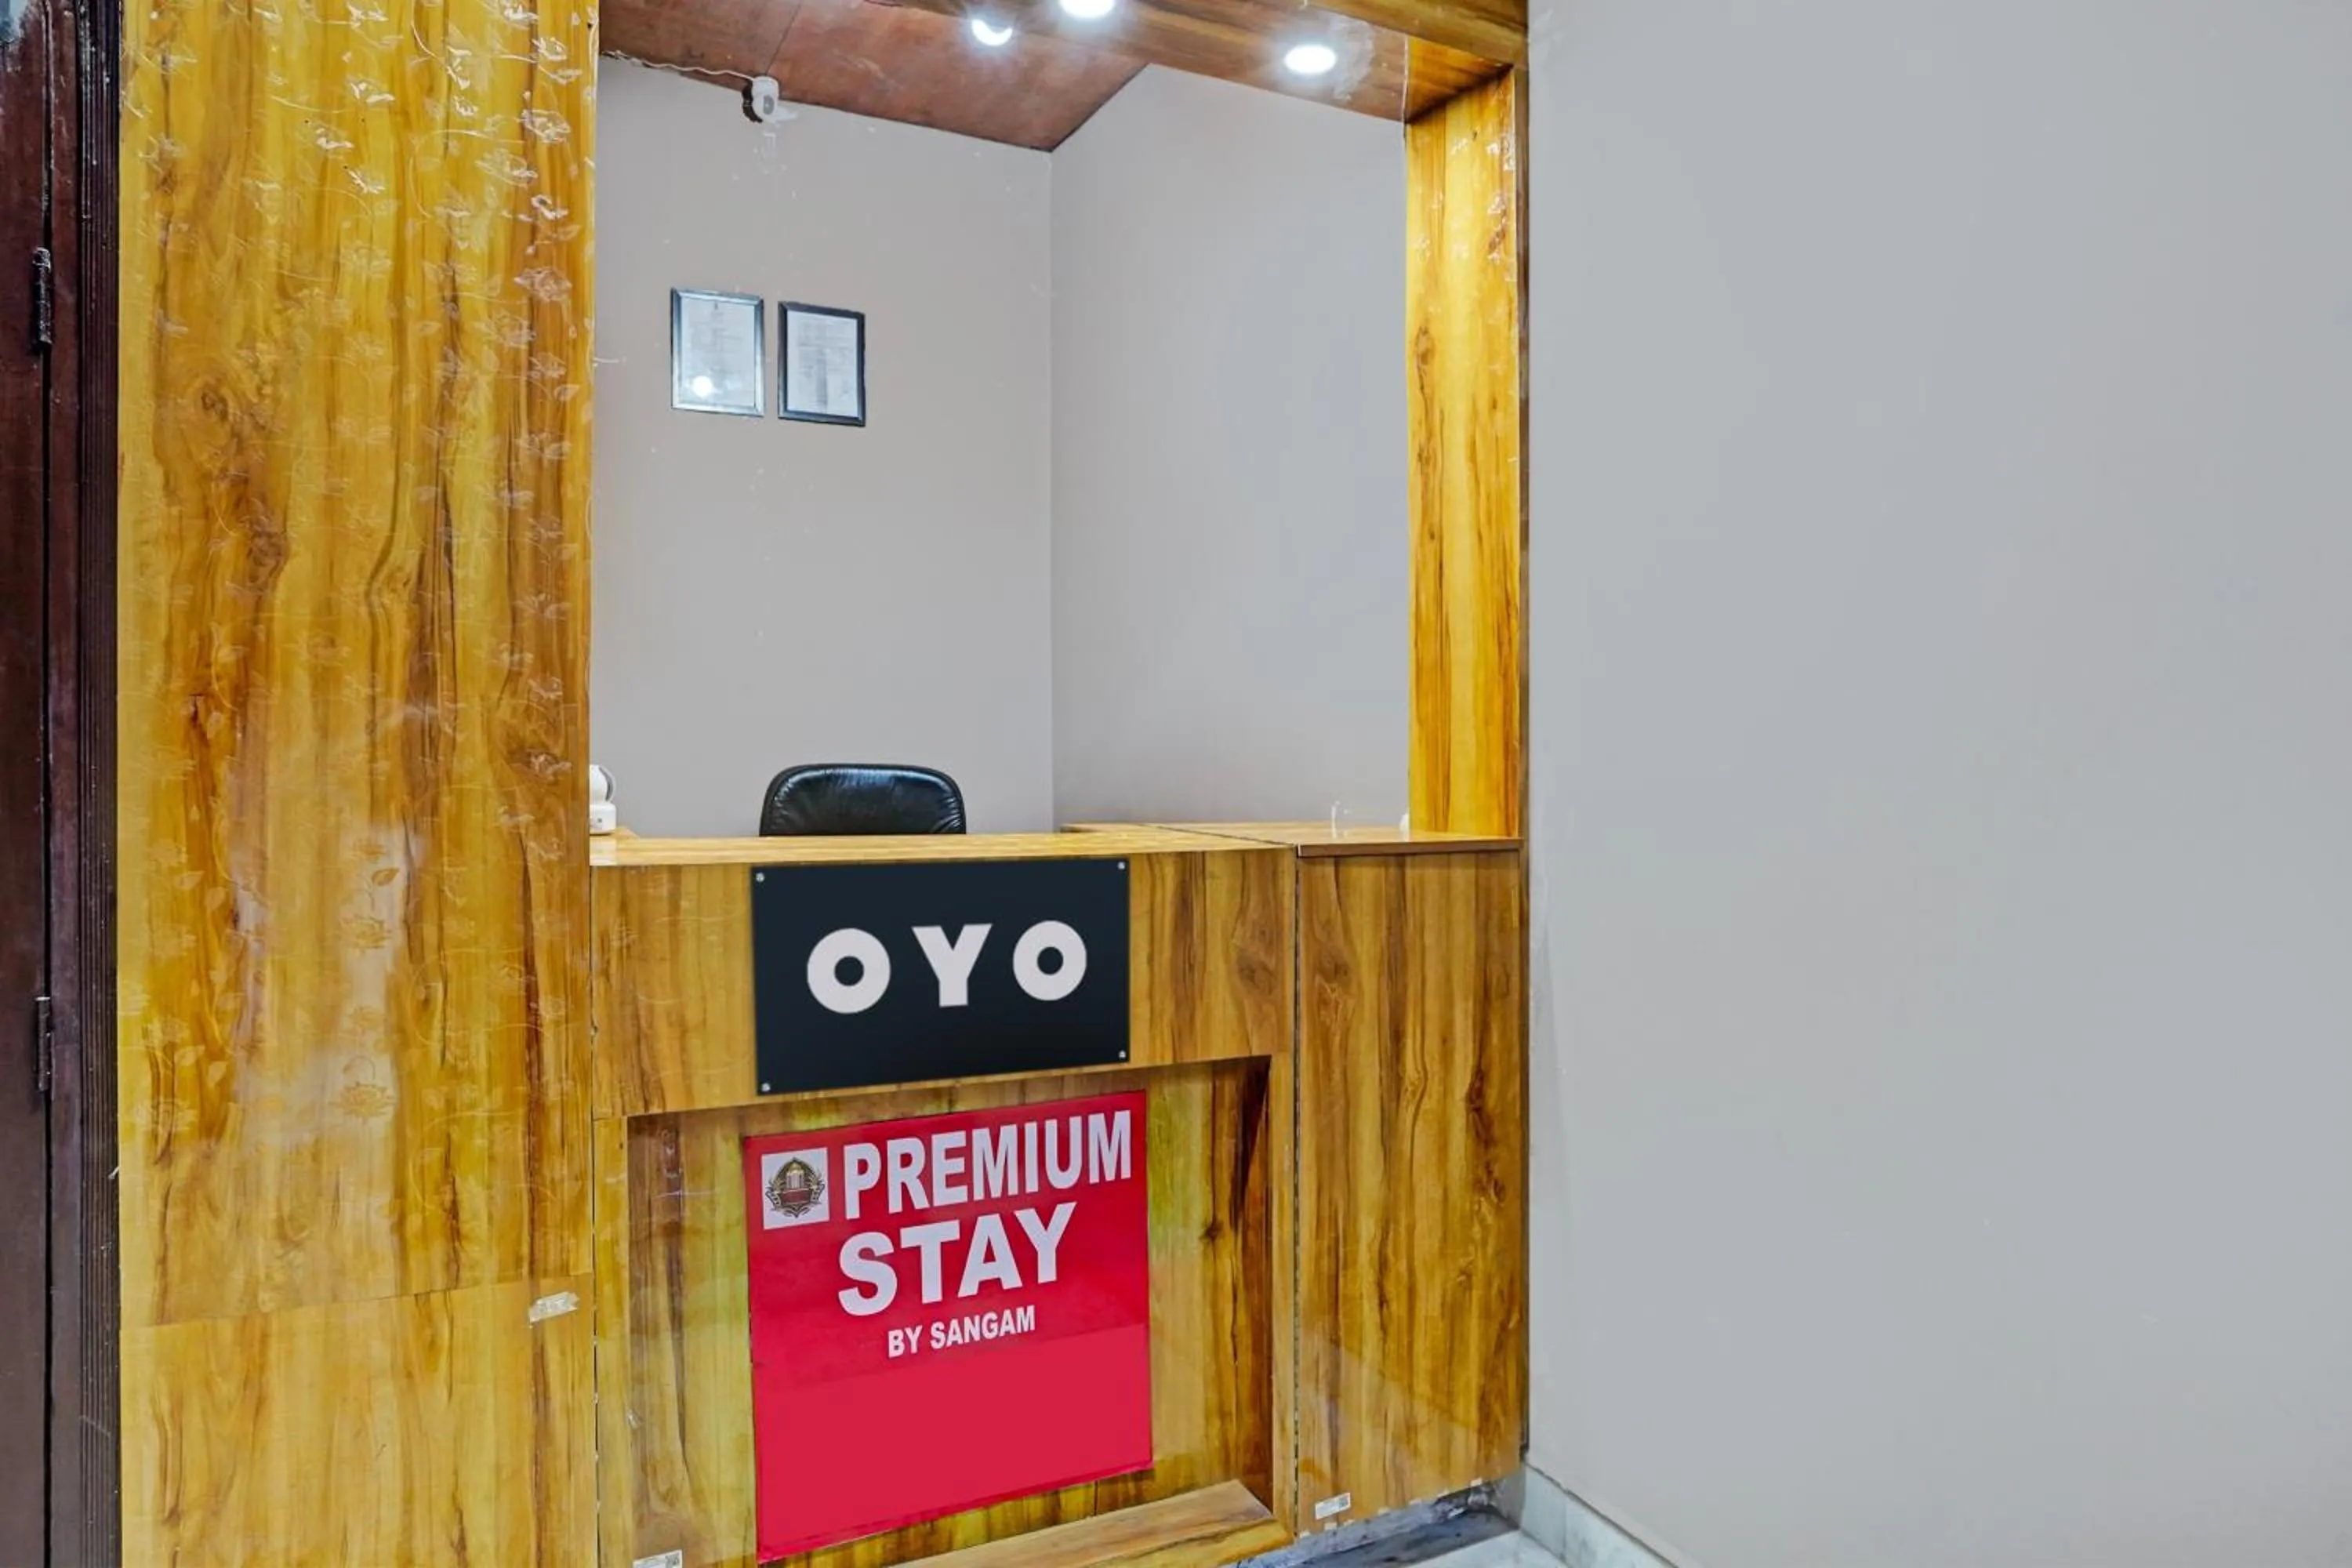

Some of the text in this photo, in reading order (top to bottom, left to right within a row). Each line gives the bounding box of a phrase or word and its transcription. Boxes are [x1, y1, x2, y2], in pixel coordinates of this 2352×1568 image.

[807, 920, 1087, 1014] OYO
[844, 1109, 1131, 1220] PREMIUM
[837, 1201, 1077, 1316] STAY
[887, 1305, 1036, 1358] BY SANGAM
